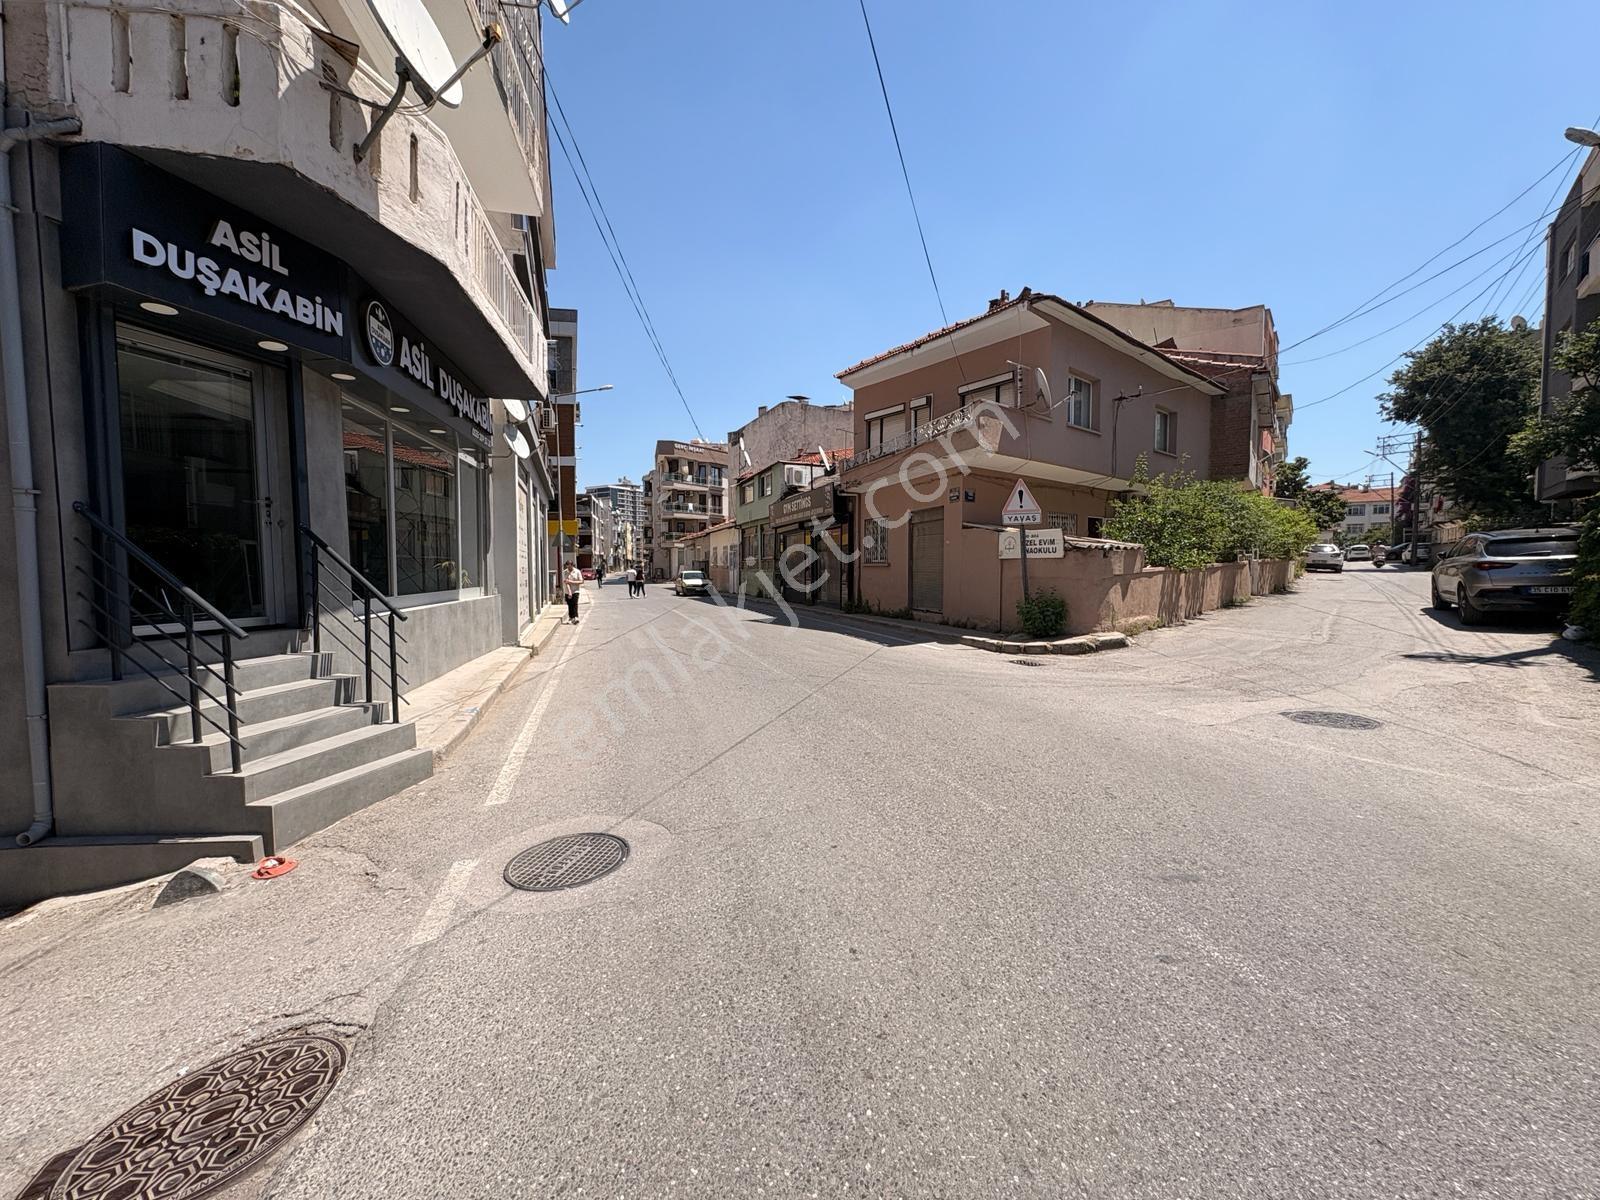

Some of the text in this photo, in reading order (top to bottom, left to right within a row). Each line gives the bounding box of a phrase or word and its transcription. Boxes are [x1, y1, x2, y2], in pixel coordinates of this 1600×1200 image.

[209, 219, 288, 276] ASİL
[132, 228, 344, 337] DUŞAKABİN
[400, 335, 435, 390] ASİL
[1025, 539, 1037, 547] ZEL
